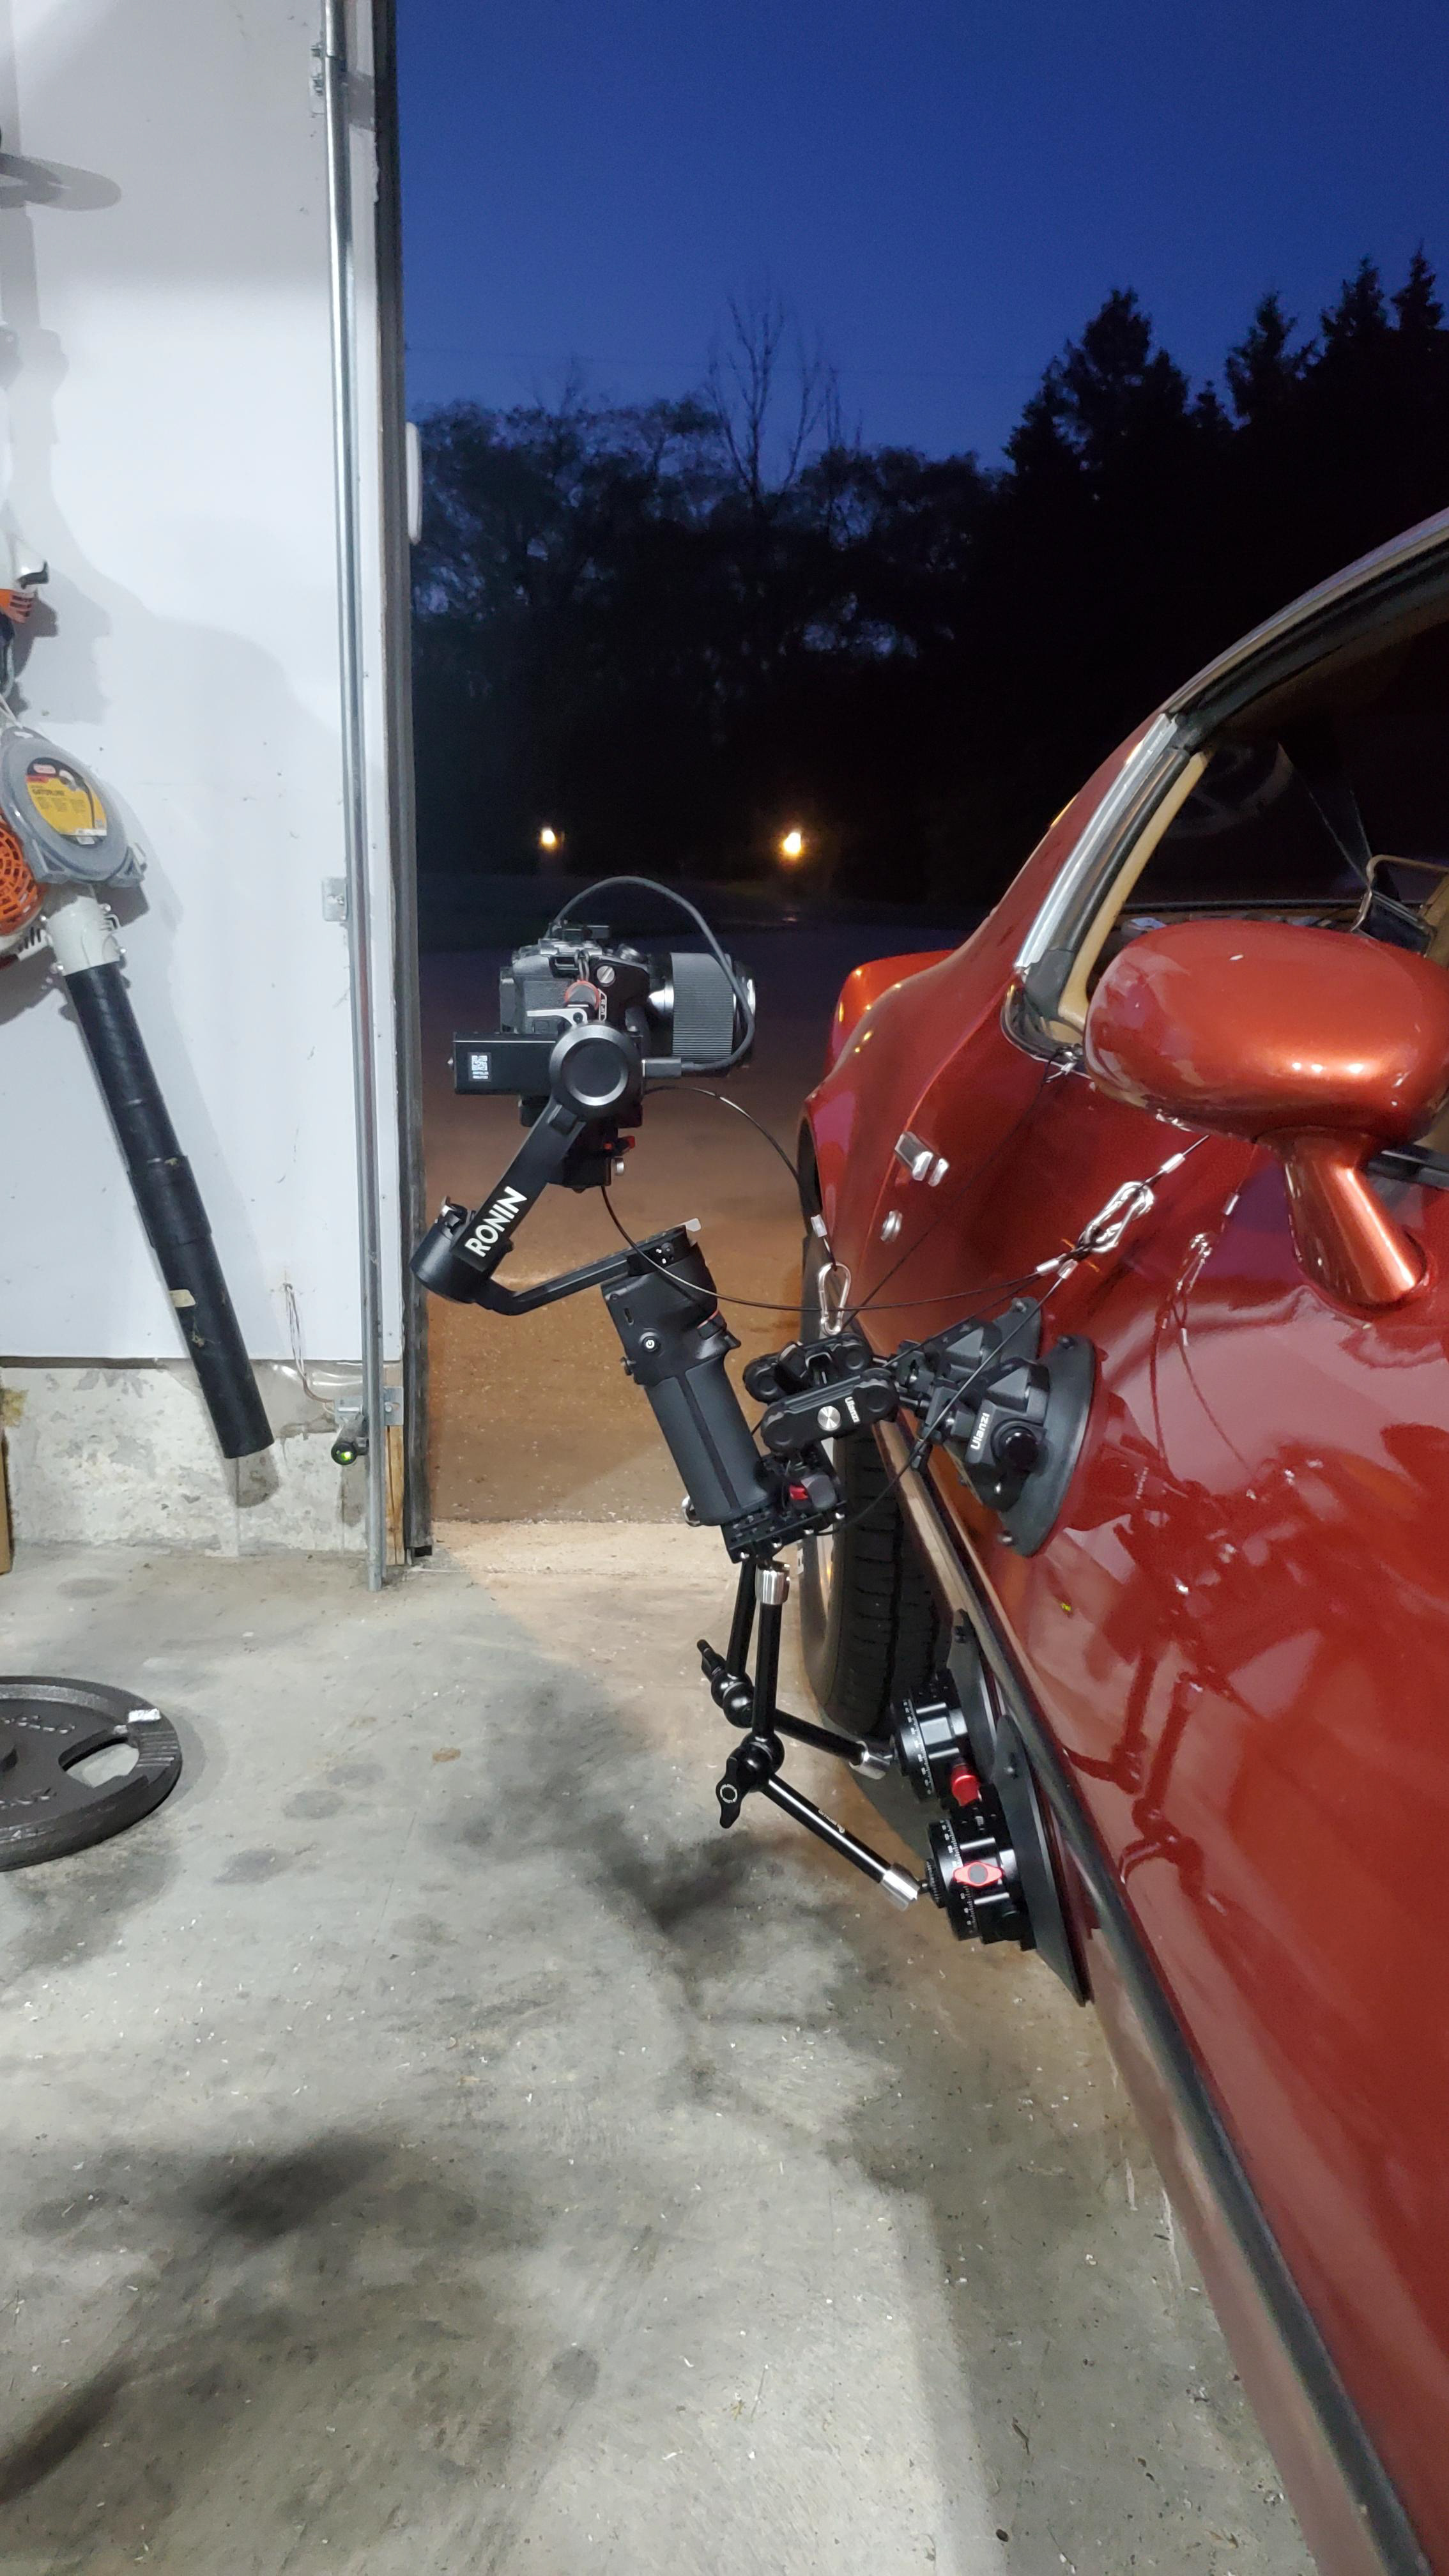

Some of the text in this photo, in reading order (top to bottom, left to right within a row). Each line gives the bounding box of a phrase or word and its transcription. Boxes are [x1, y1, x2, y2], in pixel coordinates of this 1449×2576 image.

[464, 1186, 528, 1257] RONIN
[845, 1396, 861, 1423] Ulanzi
[970, 1412, 990, 1450] Ulanzi
